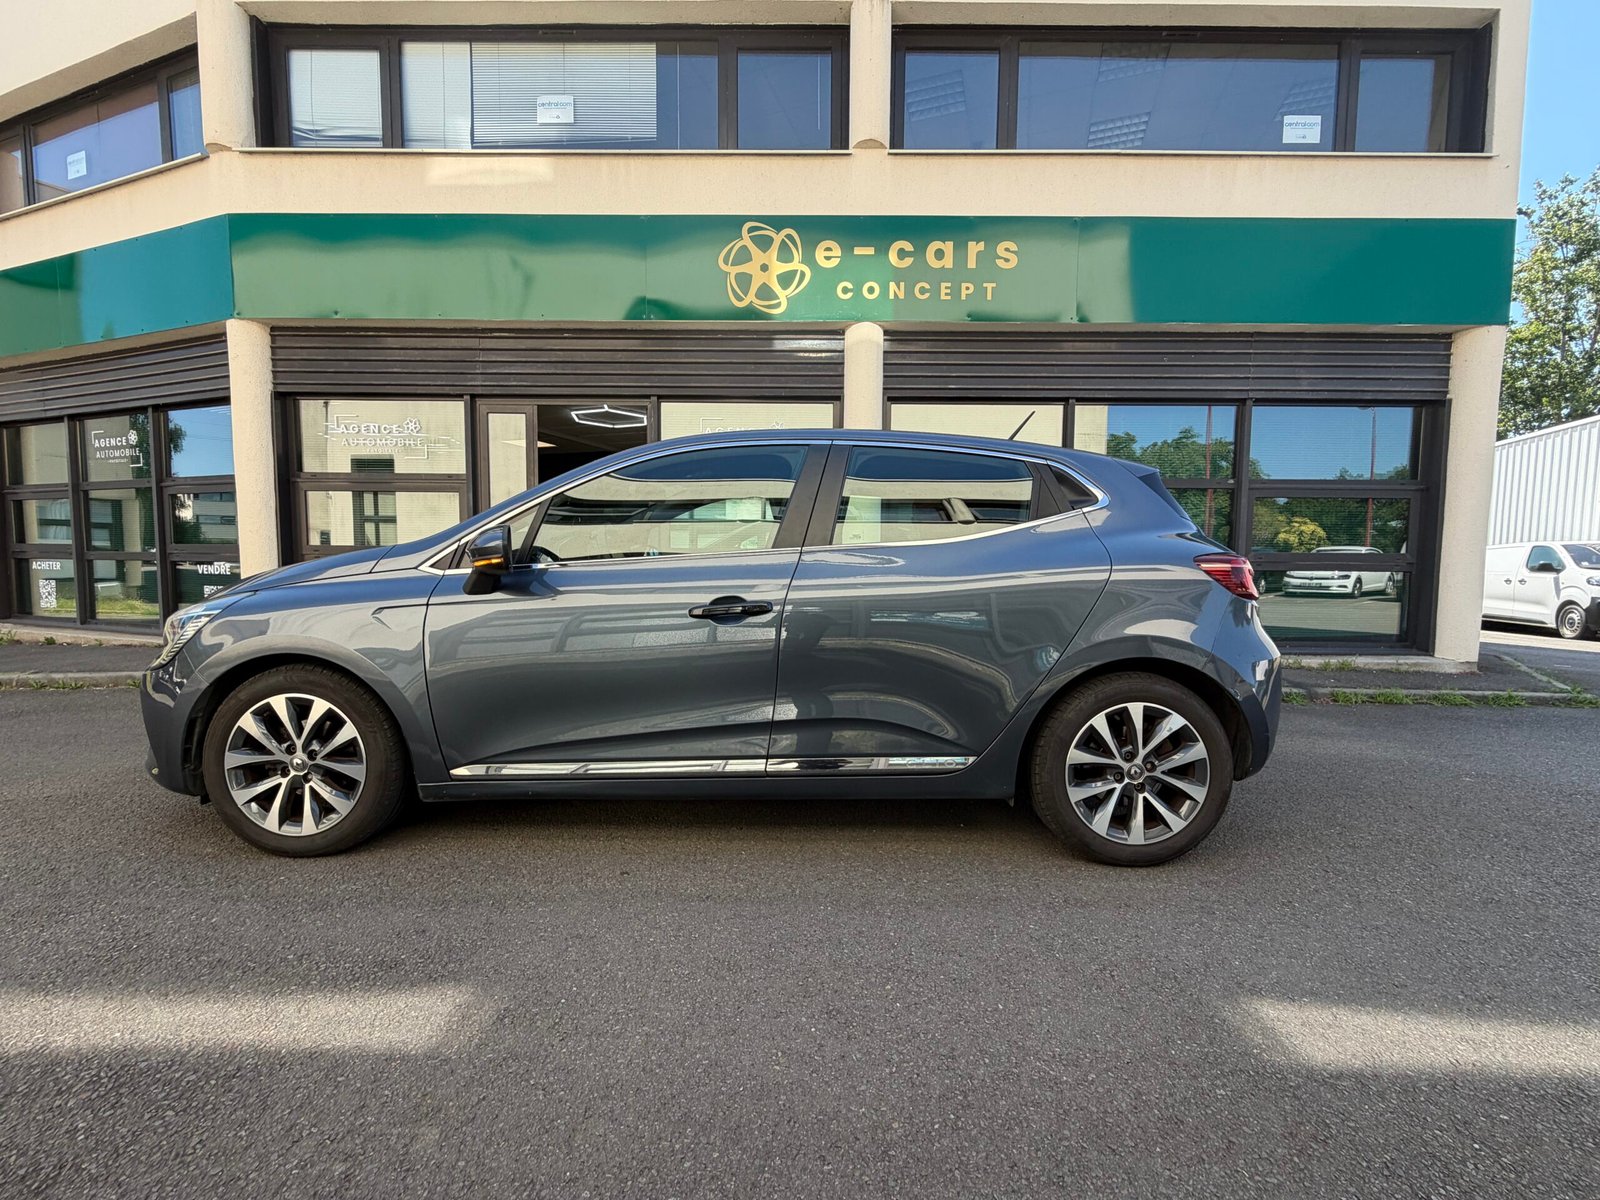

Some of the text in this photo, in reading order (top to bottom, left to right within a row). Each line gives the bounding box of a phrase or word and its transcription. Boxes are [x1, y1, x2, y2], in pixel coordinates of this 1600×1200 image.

[815, 240, 1019, 269] e-cars
[836, 281, 997, 300] CONCEPT
[340, 424, 400, 434] AGENCE
[94, 436, 127, 448] AGENCE
[341, 438, 424, 447] AUTOMOBILE
[96, 447, 140, 459] AUTOMOBILE
[32, 561, 61, 570] ACHETER
[197, 564, 231, 575] VENDRE
